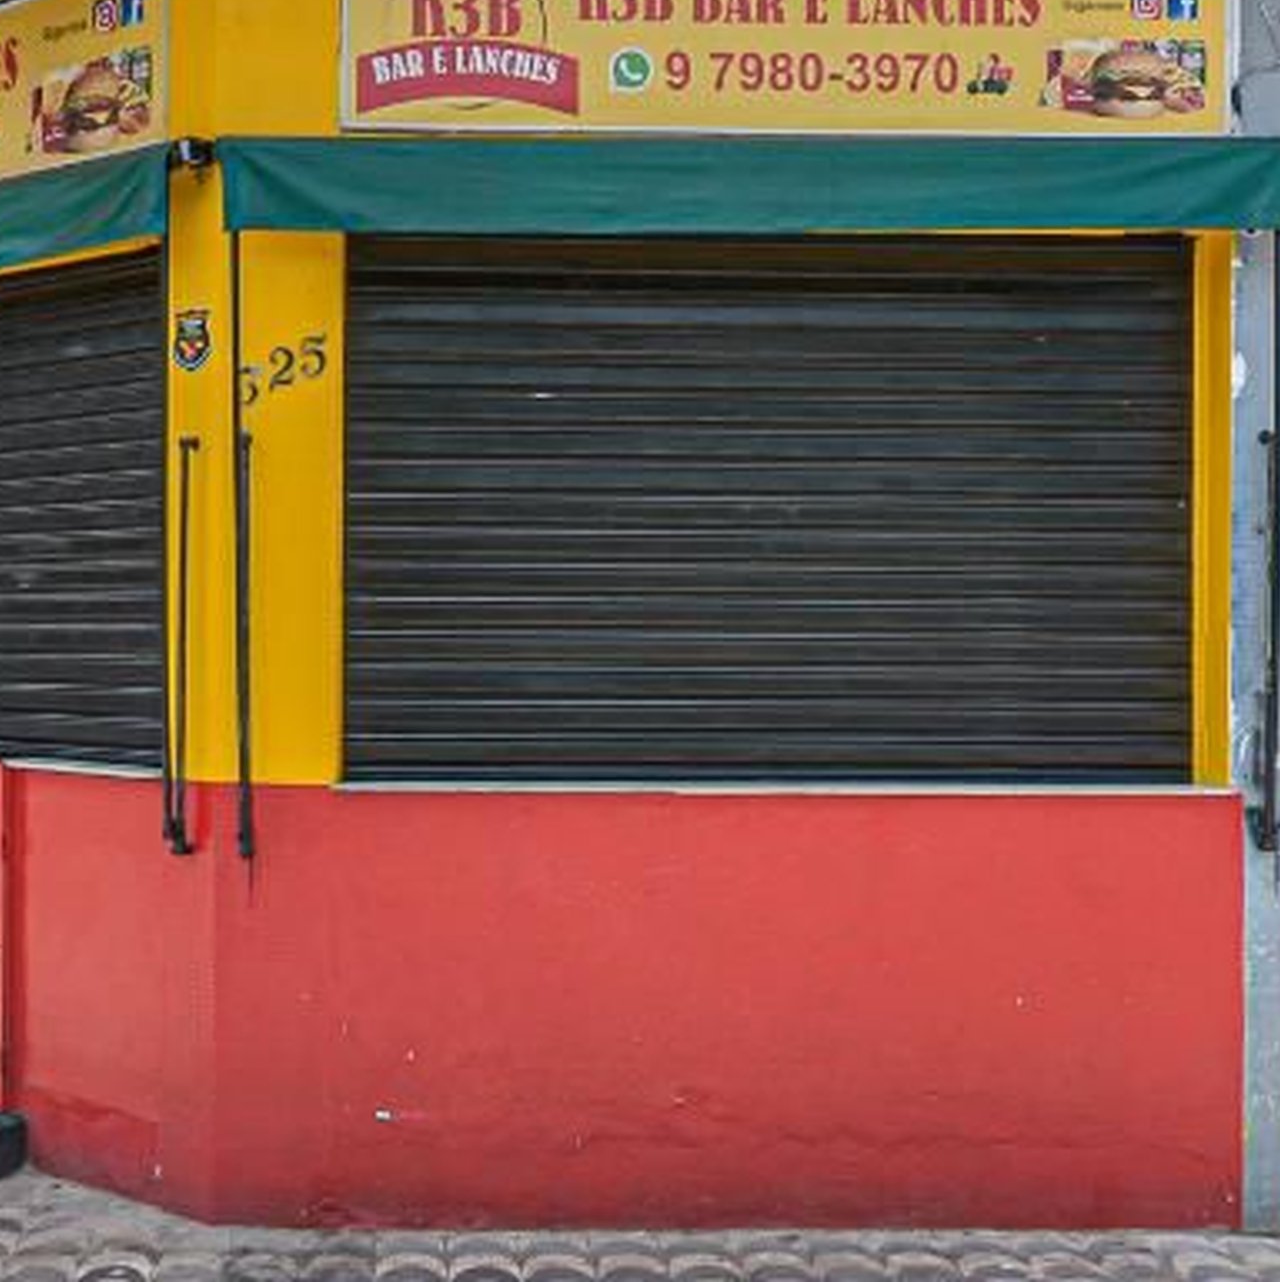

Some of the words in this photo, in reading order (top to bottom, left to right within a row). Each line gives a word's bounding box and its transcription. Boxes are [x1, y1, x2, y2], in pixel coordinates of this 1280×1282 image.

[372, 49, 425, 84] BAR
[432, 45, 447, 75] E
[455, 45, 561, 84] LANCHES
[665, 51, 691, 90] 9
[709, 52, 959, 92] 7980-3970
[239, 331, 328, 406] 525
